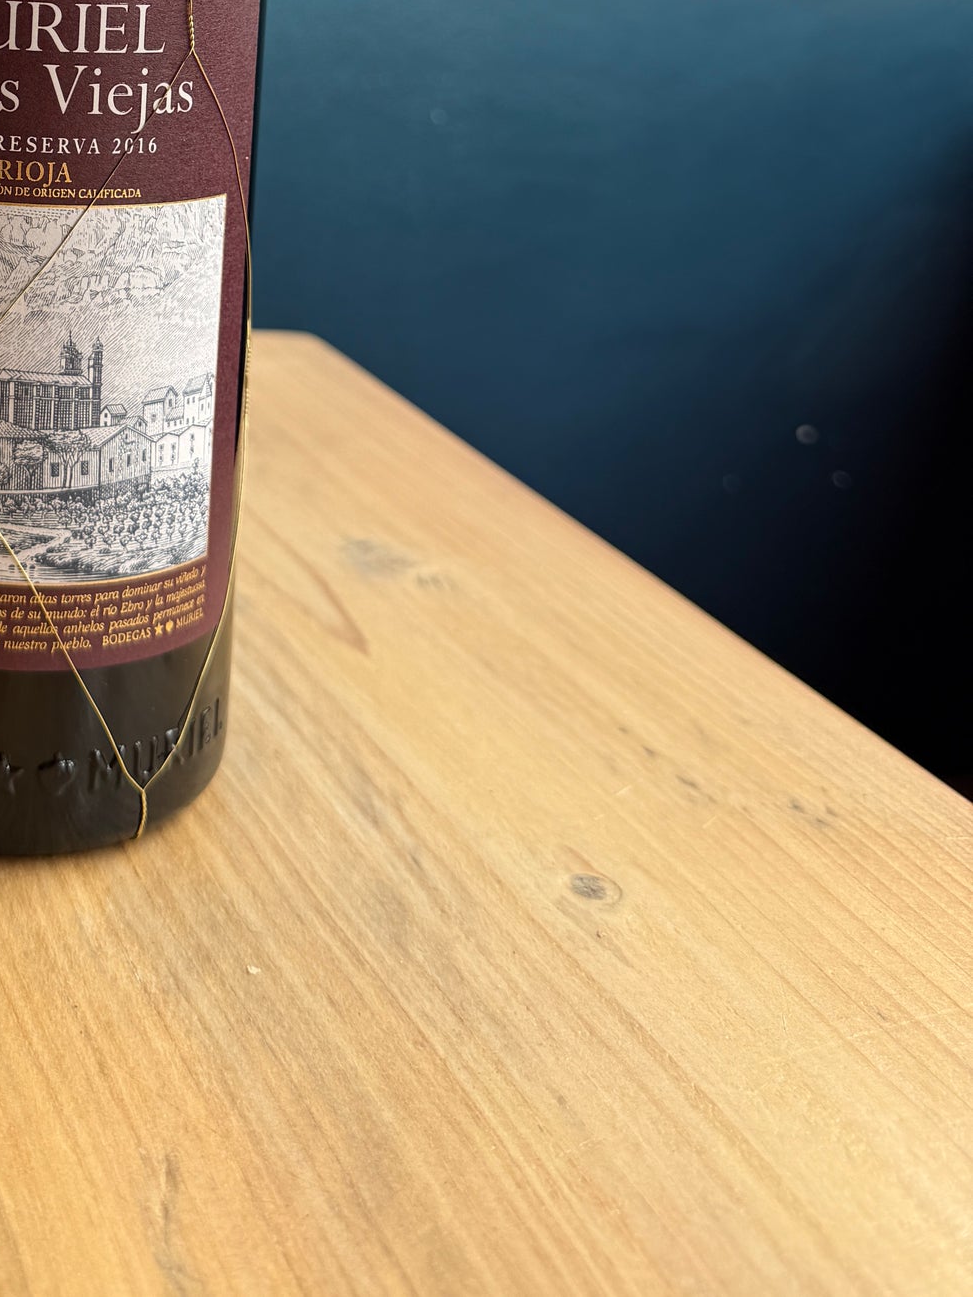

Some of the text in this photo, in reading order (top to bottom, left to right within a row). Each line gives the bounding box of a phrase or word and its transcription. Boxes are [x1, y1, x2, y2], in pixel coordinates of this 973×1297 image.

[43, 64, 194, 135] Viejas
[112, 136, 158, 155] 2016
[14, 185, 30, 197] DE
[32, 185, 77, 199] ORIGEN
[78, 188, 143, 200] CALIFICADA
[30, 591, 58, 604] altas
[61, 593, 91, 604] torres
[94, 590, 119, 605] para
[122, 582, 163, 598] dominar
[163, 578, 174, 589] su
[201, 564, 207, 577] y
[11, 606, 25, 619] de
[27, 610, 41, 619] su
[46, 607, 88, 619] mundo:
[90, 605, 100, 617] el
[103, 603, 118, 616] río
[120, 600, 144, 613] Ebro
[145, 599, 153, 611] y
[155, 594, 164, 606] la
[12, 622, 58, 637] aquellos
[63, 620, 105, 634] anhelos
[109, 613, 149, 633] pasados
[152, 599, 195, 624] permanece
[196, 593, 206, 605] en
[102, 607, 204, 646] BODEGAS MURIEL
[3, 640, 48, 650] nuestro
[51, 637, 92, 654] pueblo.
